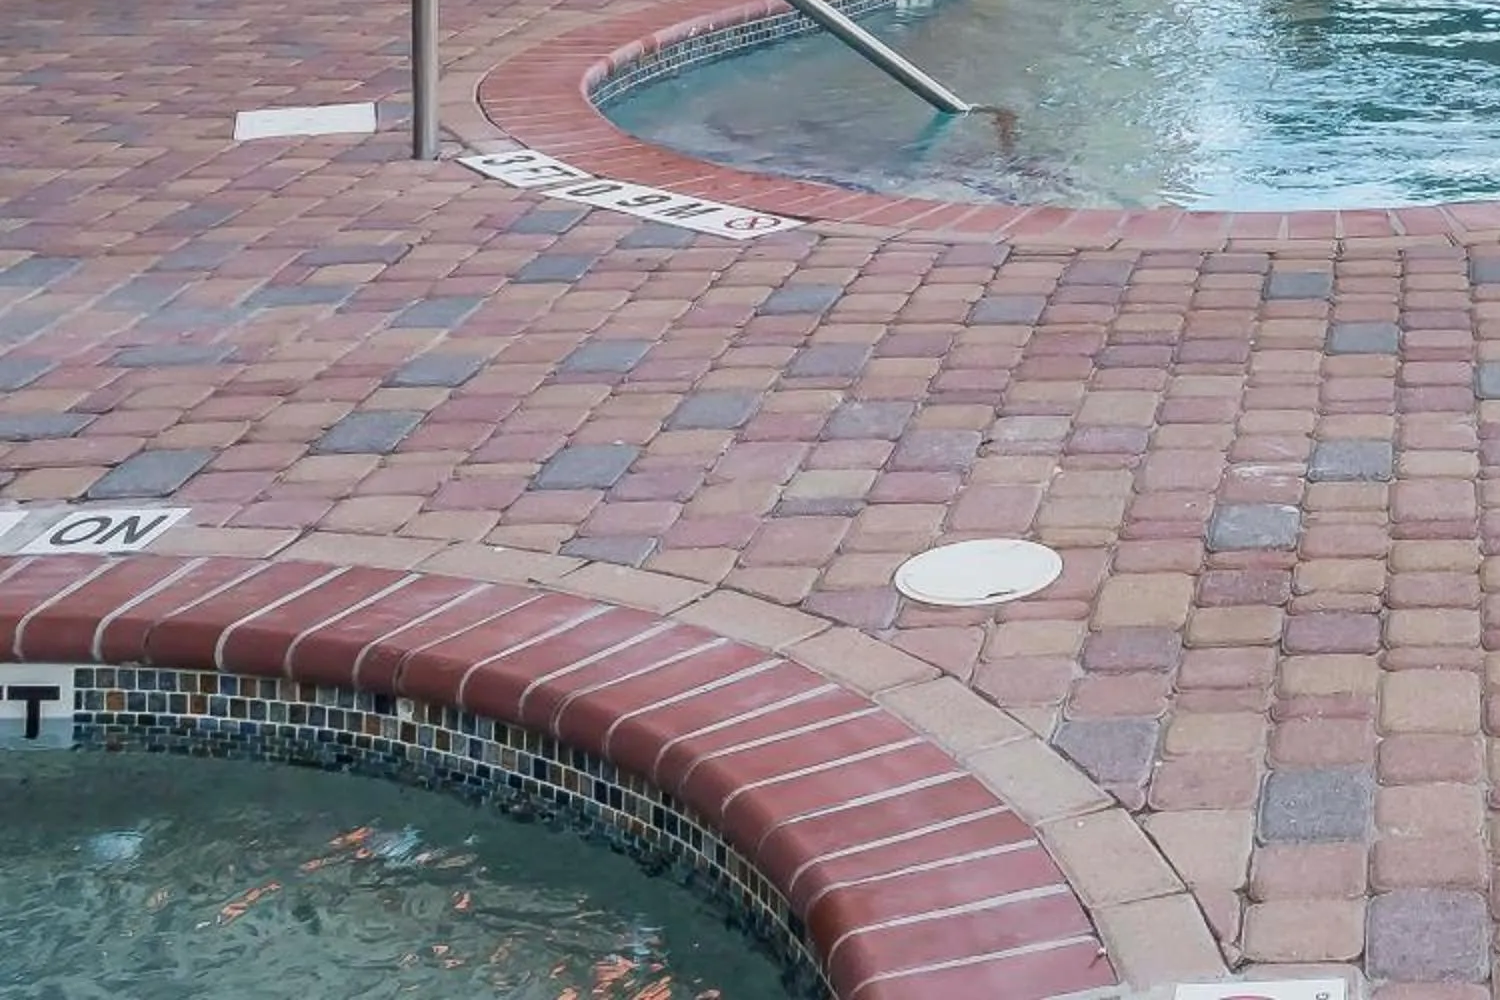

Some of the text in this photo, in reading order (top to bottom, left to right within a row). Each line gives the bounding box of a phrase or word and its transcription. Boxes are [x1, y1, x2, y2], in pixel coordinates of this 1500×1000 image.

[482, 155, 535, 166] 3
[503, 165, 578, 181] FT
[50, 515, 169, 545] ON
[0, 685, 60, 739] T
